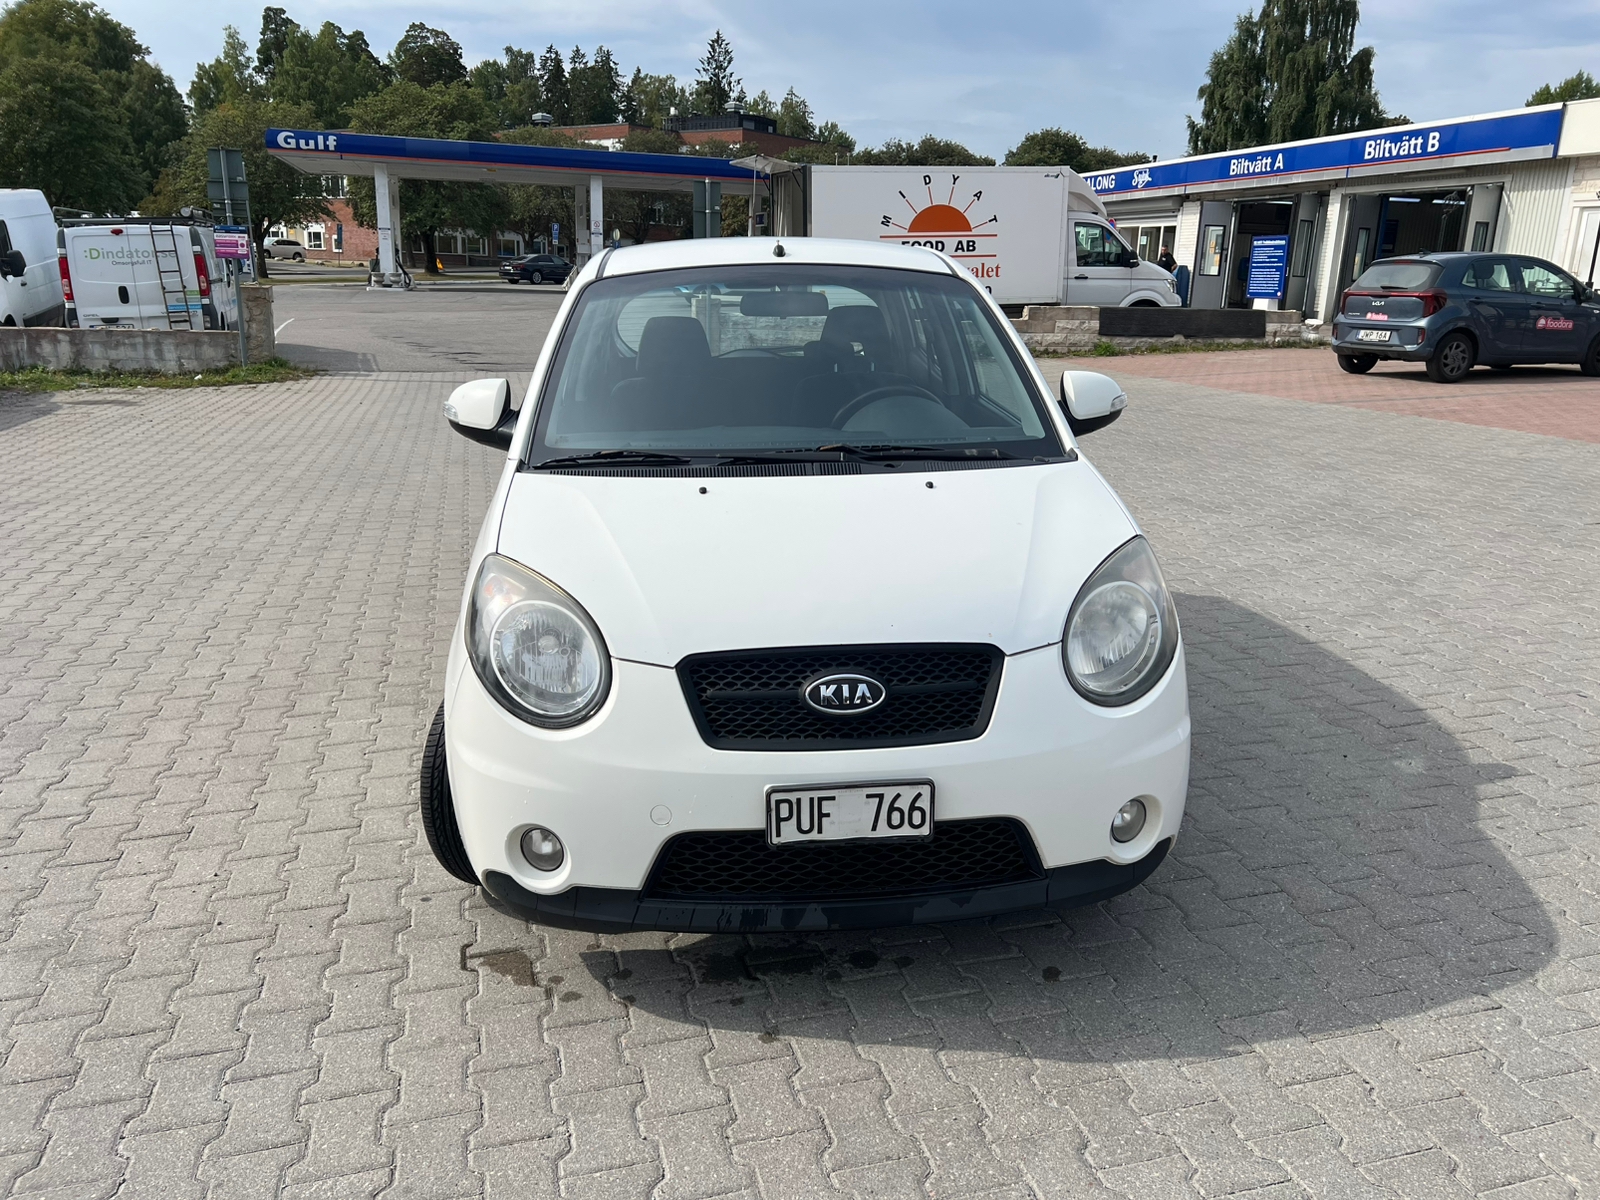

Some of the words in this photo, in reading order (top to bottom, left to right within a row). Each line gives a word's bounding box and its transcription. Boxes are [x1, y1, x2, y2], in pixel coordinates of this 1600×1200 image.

[276, 131, 337, 151] Gulf
[1364, 135, 1424, 160] Biltvätt
[1427, 131, 1440, 152] B
[1230, 156, 1272, 175] Biltvätt
[1273, 153, 1283, 170] A
[1083, 174, 1115, 190] ALONG
[954, 240, 977, 252] AB
[1547, 317, 1573, 328] foodora
[819, 683, 873, 705] KIA
[774, 796, 836, 837] PUF
[865, 791, 926, 831] 766
